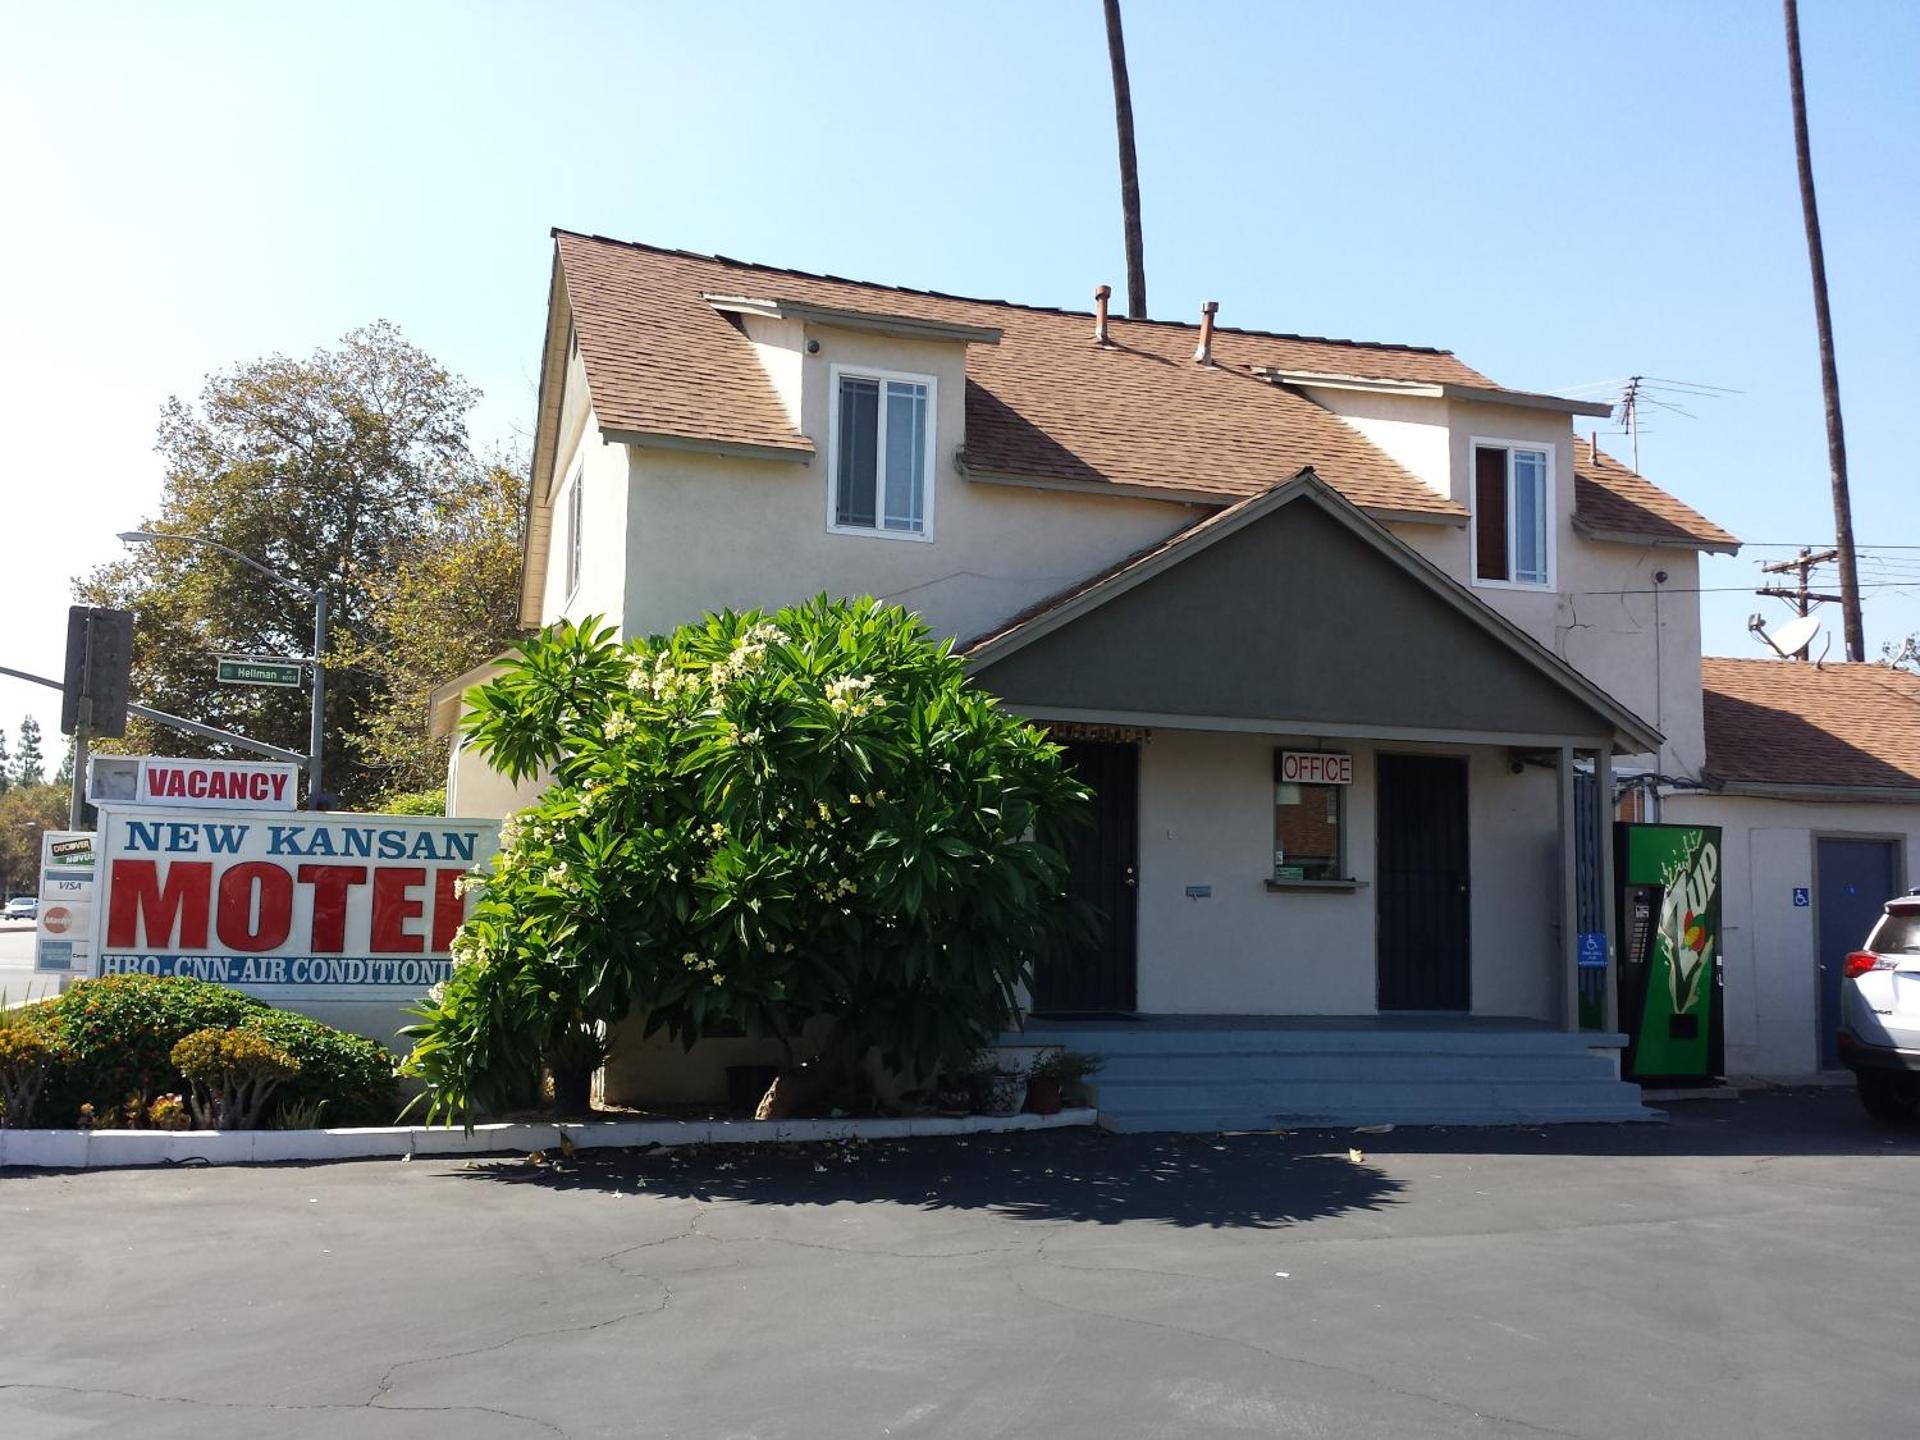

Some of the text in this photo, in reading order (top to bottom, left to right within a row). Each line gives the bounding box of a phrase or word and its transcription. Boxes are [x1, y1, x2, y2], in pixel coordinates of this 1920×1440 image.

[237, 667, 278, 680] Hellman
[1284, 755, 1350, 782] OFFICE
[148, 768, 289, 801] VACANCY
[124, 821, 479, 860] NEW KANSAN
[59, 881, 82, 890] VISA
